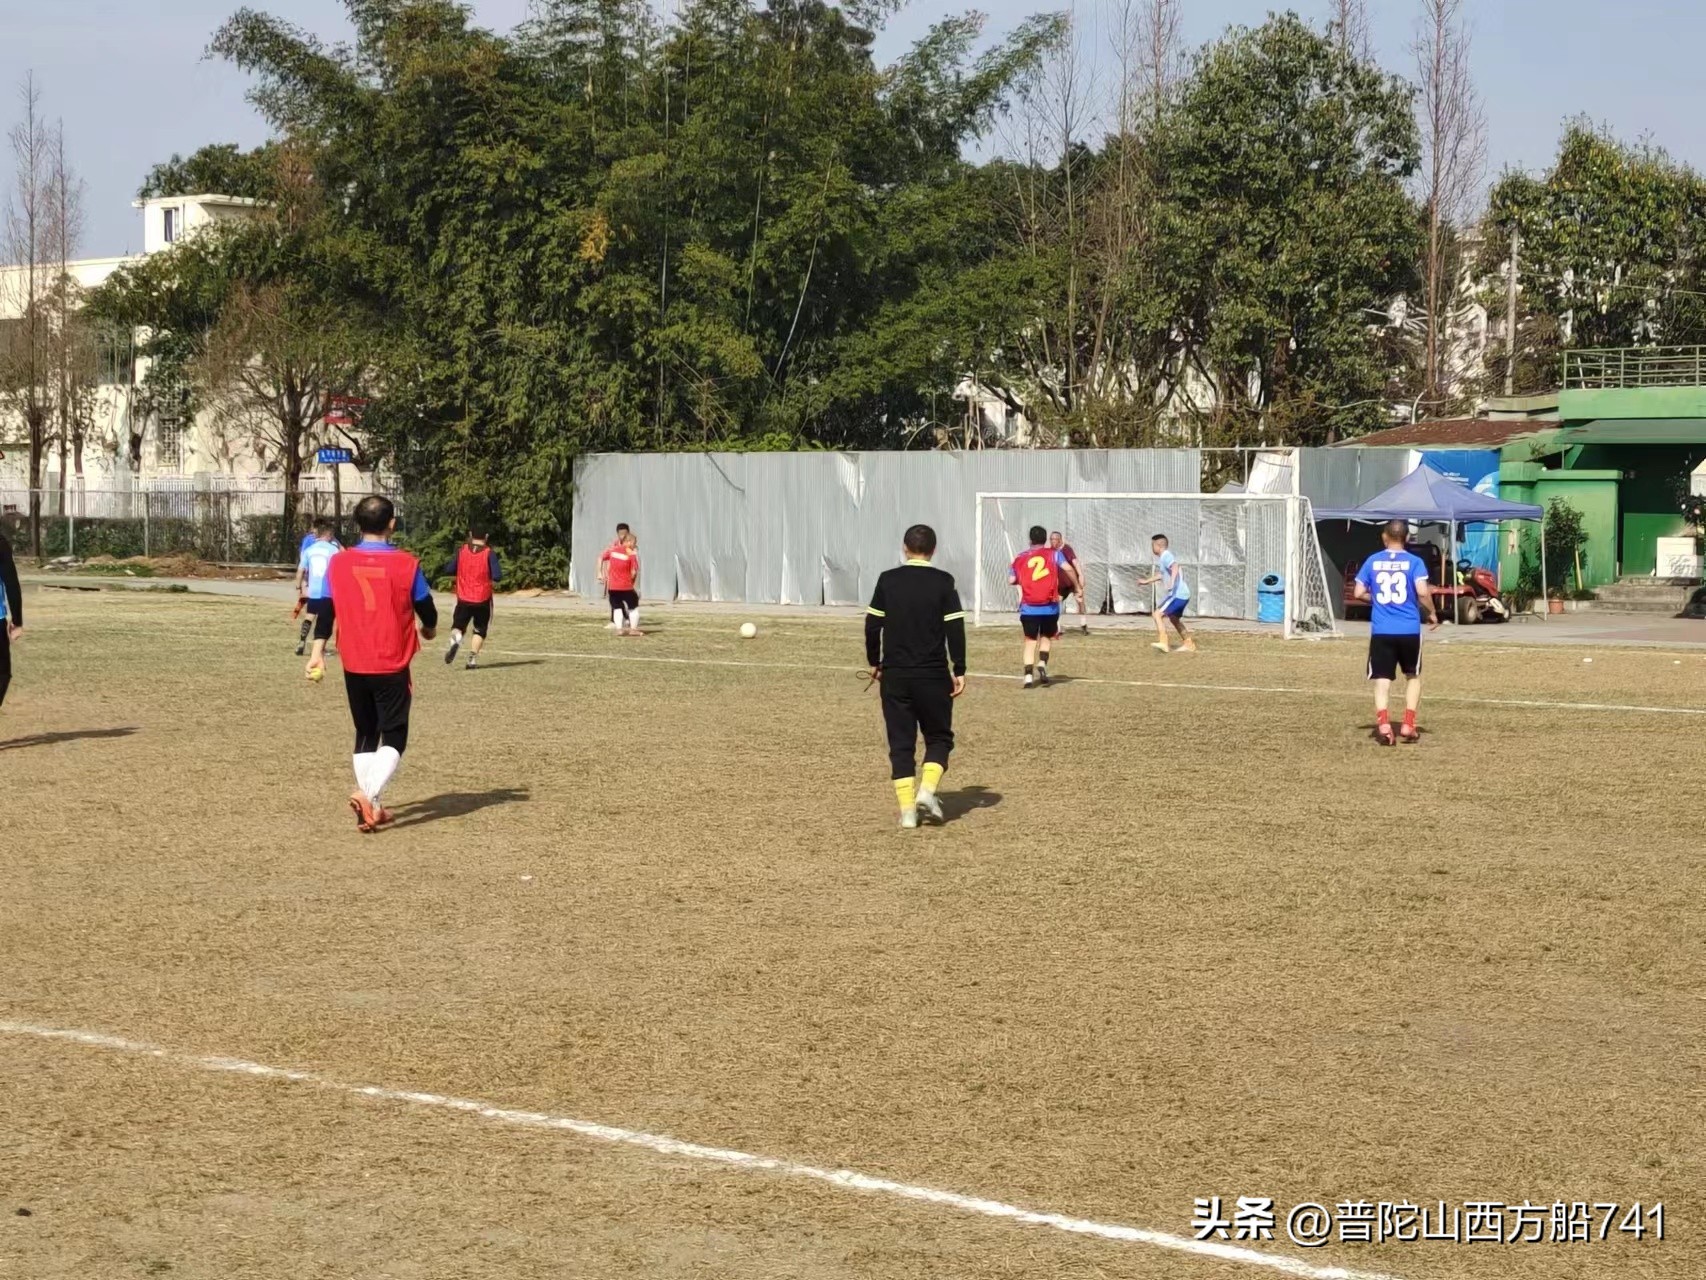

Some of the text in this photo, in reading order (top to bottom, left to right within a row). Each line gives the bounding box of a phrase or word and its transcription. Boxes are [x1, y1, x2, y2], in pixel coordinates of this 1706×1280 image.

[1027, 555, 1050, 581] 2
[351, 565, 385, 611] 7
[1375, 571, 1407, 605] 33
